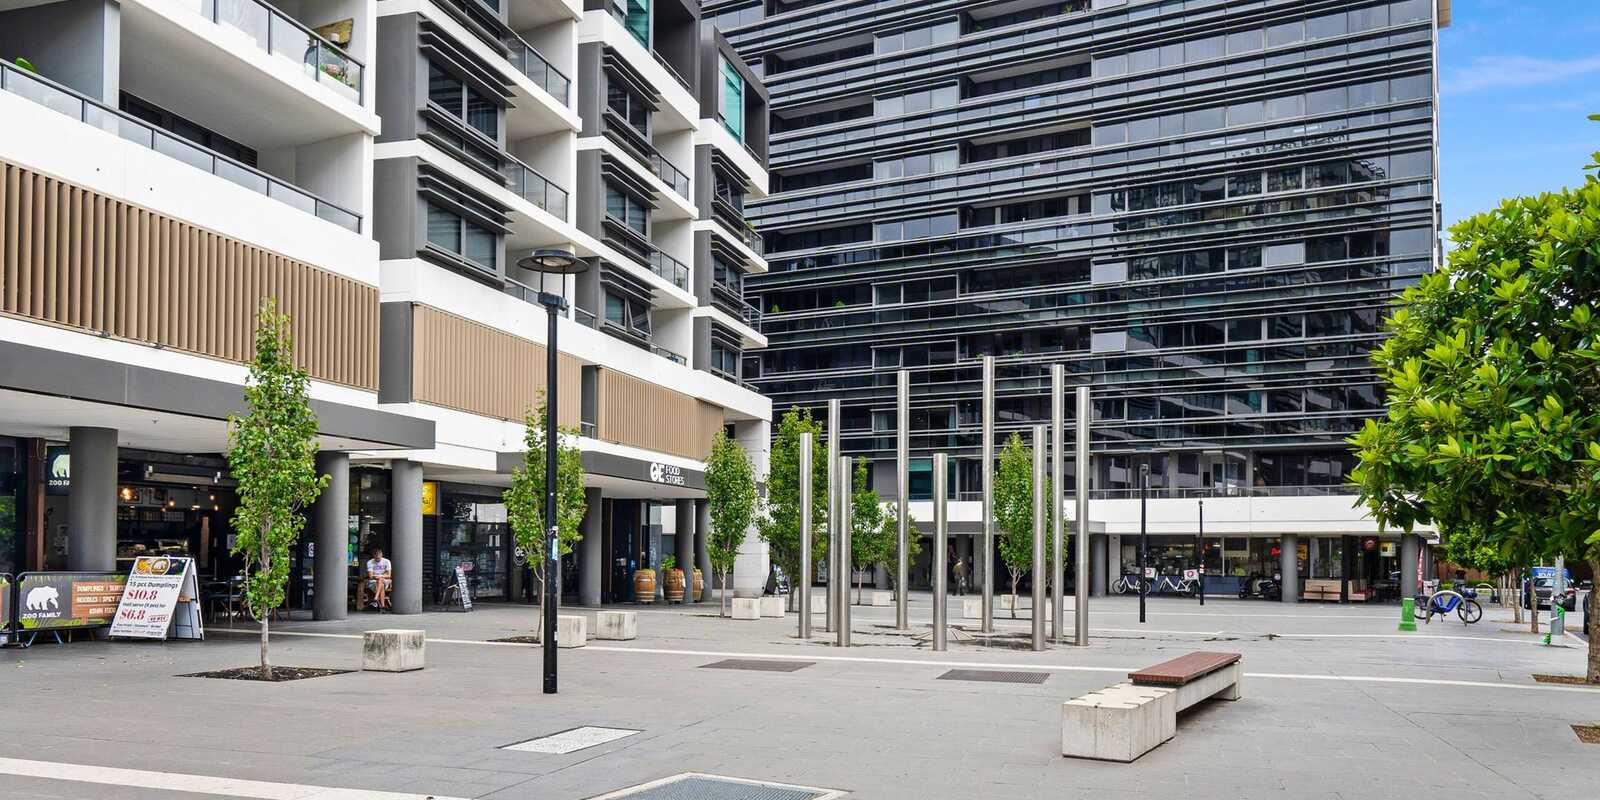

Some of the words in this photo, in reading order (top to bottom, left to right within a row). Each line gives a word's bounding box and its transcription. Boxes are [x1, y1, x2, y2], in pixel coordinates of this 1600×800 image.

[666, 465, 680, 475] FOOD
[666, 475, 685, 485] STORES
[128, 589, 158, 600] $10.8
[121, 609, 146, 620] $6.8
